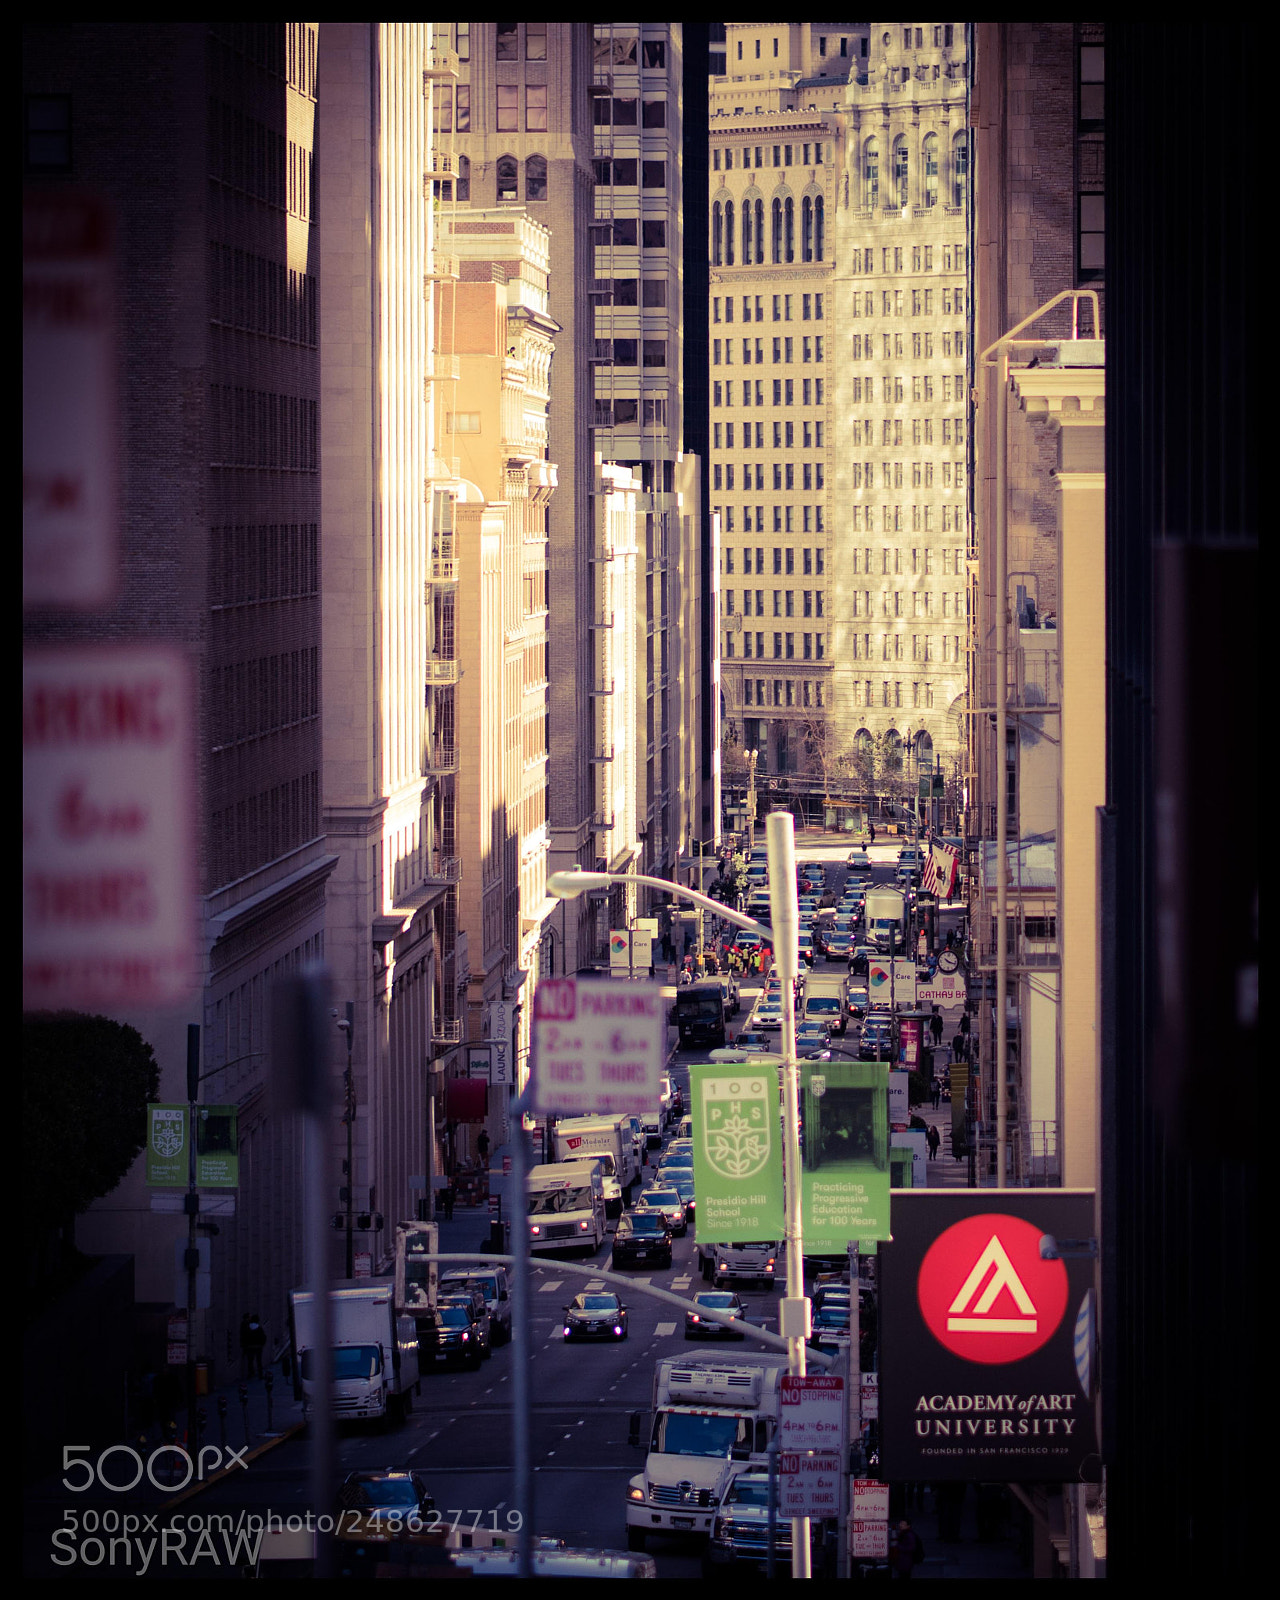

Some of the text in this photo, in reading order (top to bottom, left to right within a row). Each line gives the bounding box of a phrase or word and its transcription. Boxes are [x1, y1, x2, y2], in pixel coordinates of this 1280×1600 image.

[919, 990, 953, 999] CATHAY
[498, 1004, 506, 1082] LAUNCSQUAD
[812, 1182, 864, 1194] Practicing
[706, 1195, 766, 1206] Presidio Hill
[812, 1194, 869, 1205] Progressive
[706, 1207, 741, 1217] School
[812, 1205, 863, 1214] Education
[707, 1216, 759, 1228] Since 1918
[812, 1215, 877, 1225] for 100 Years
[788, 1378, 837, 1387] TOW-AWAY
[782, 1388, 842, 1404] NO STOPPING
[915, 1394, 1077, 1415] ACADEMY of ART
[915, 1418, 1076, 1436] UNIVERSITY
[922, 1447, 964, 1455] FOUNDED
[782, 1456, 838, 1472] NO PARKING
[854, 1487, 864, 1495] NO
[787, 1493, 834, 1503] TUES THURS
[865, 1524, 887, 1532] PARKING
